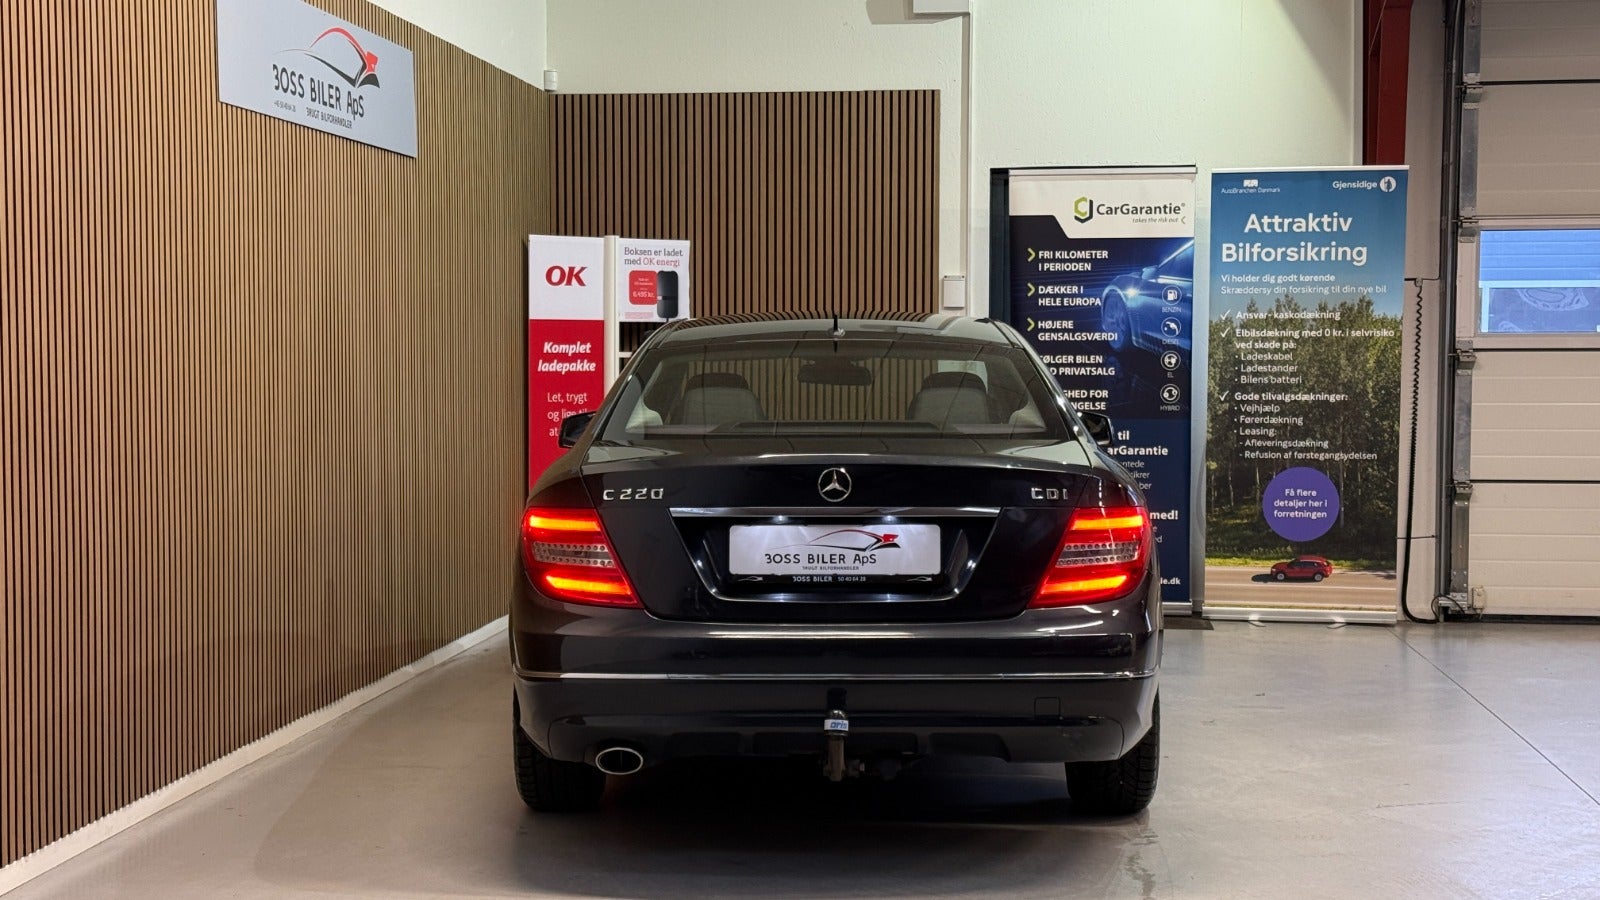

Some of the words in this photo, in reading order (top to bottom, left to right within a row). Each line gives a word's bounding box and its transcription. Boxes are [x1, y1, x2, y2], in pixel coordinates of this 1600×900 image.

[310, 77, 342, 111] BILER
[346, 91, 364, 120] ApS
[1332, 180, 1378, 190] Gjensidige
[1244, 212, 1352, 233] Attraktiv
[624, 247, 652, 256] Boksen
[664, 248, 684, 257] ladet
[1038, 250, 1054, 259] FRI
[1056, 250, 1109, 259] KILOMETER
[1222, 241, 1368, 266] Bilforsikring
[624, 257, 642, 265] med
[643, 258, 654, 266] OK
[656, 258, 680, 268] energi
[1044, 262, 1092, 271] PERIODEN
[545, 266, 588, 286] OK
[1221, 274, 1230, 282] Vi
[1232, 274, 1260, 282] holder
[1262, 274, 1276, 284] dig
[1278, 274, 1298, 284] godt
[1300, 274, 1335, 282] kørende
[1038, 286, 1078, 294] DÆKKER
[1221, 286, 1272, 295] Skræddersy
[1274, 286, 1287, 294] din
[1289, 286, 1329, 295] forsikring
[1358, 287, 1374, 295] nye
[1376, 285, 1387, 293] bil
[1038, 298, 1062, 306] HELE
[1064, 298, 1102, 306] EUROPA
[1274, 311, 1341, 320] kaskodækning
[1038, 320, 1074, 329] HØJERE
[1038, 332, 1118, 341] GENSALGSVÆRDI
[1236, 329, 1300, 338] Elbilsdækning
[1302, 329, 1322, 337] med
[1351, 329, 1394, 337] selvrisiko
[544, 341, 591, 356] Komplet
[1235, 341, 1252, 349] ved
[1254, 341, 1280, 349] skade
[1282, 340, 1297, 350] på:
[1076, 355, 1102, 364] BILEN
[538, 360, 596, 375] ladepakke
[1059, 367, 1115, 376] PRIVATSALG
[1240, 364, 1298, 372] Ladestander
[1240, 376, 1268, 384] Bilens
[1271, 376, 1302, 384] batteri
[548, 392, 564, 403] Let,
[566, 392, 588, 404] trygt
[1090, 390, 1109, 398] FOR
[1234, 392, 1260, 401] Gode
[1262, 392, 1348, 403] tilvalgsdækninger:
[1071, 402, 1106, 410] NGELSE
[1240, 404, 1280, 414] Vejhjælp
[548, 411, 560, 422] og
[1240, 416, 1303, 425] Førerdækning
[1118, 430, 1130, 440] til
[1240, 428, 1277, 437] Leasing:
[1245, 440, 1329, 449] Afleveringsdækning
[1108, 445, 1168, 455] arGarantie
[1245, 451, 1282, 459] Refusion
[1284, 451, 1292, 459] af
[1294, 451, 1377, 461] førstegangsydelsen
[1122, 460, 1144, 468] ntede
[602, 489, 614, 500] C
[620, 488, 664, 500] 220
[1031, 488, 1068, 500] CDI
[1285, 488, 1295, 497] Få
[1296, 489, 1317, 497] flere
[1274, 500, 1307, 508] detaljer
[1150, 510, 1178, 520] med!
[1274, 510, 1328, 520] forretningen
[808, 554, 846, 564] BILER
[853, 554, 877, 566] ApS
